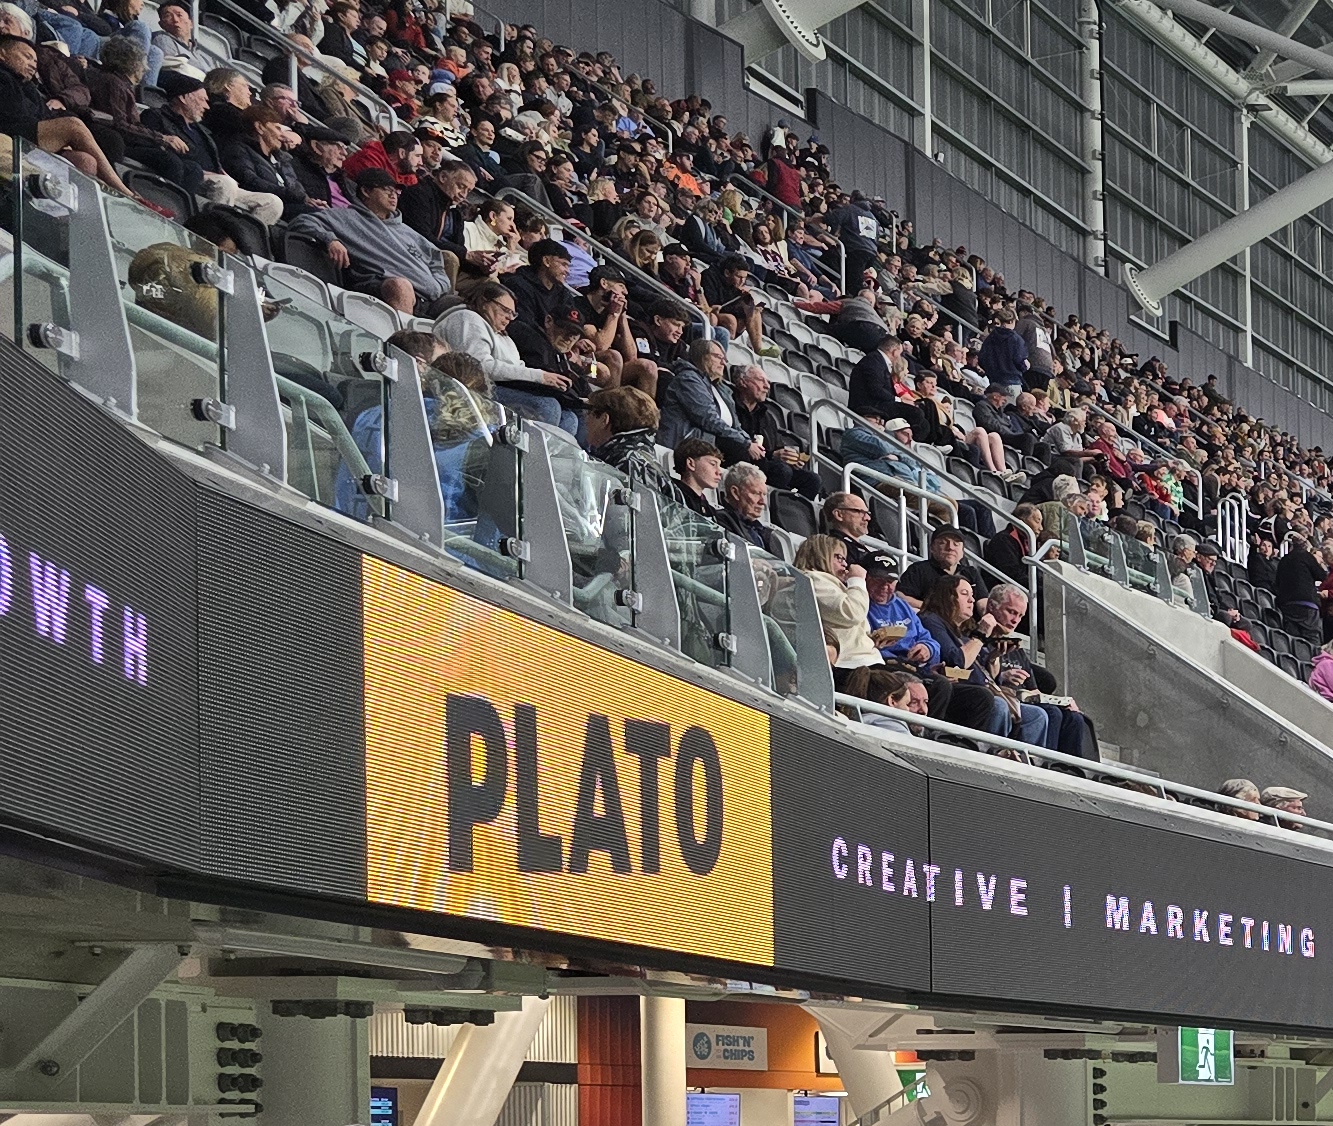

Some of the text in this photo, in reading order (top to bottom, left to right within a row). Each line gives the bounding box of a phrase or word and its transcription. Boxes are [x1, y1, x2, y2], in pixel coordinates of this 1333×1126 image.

[444, 692, 724, 877] PLATO
[831, 836, 1029, 916] CREATIVE
[1105, 893, 1316, 958] MARKETING
[722, 1048, 755, 1061] CHIPS
